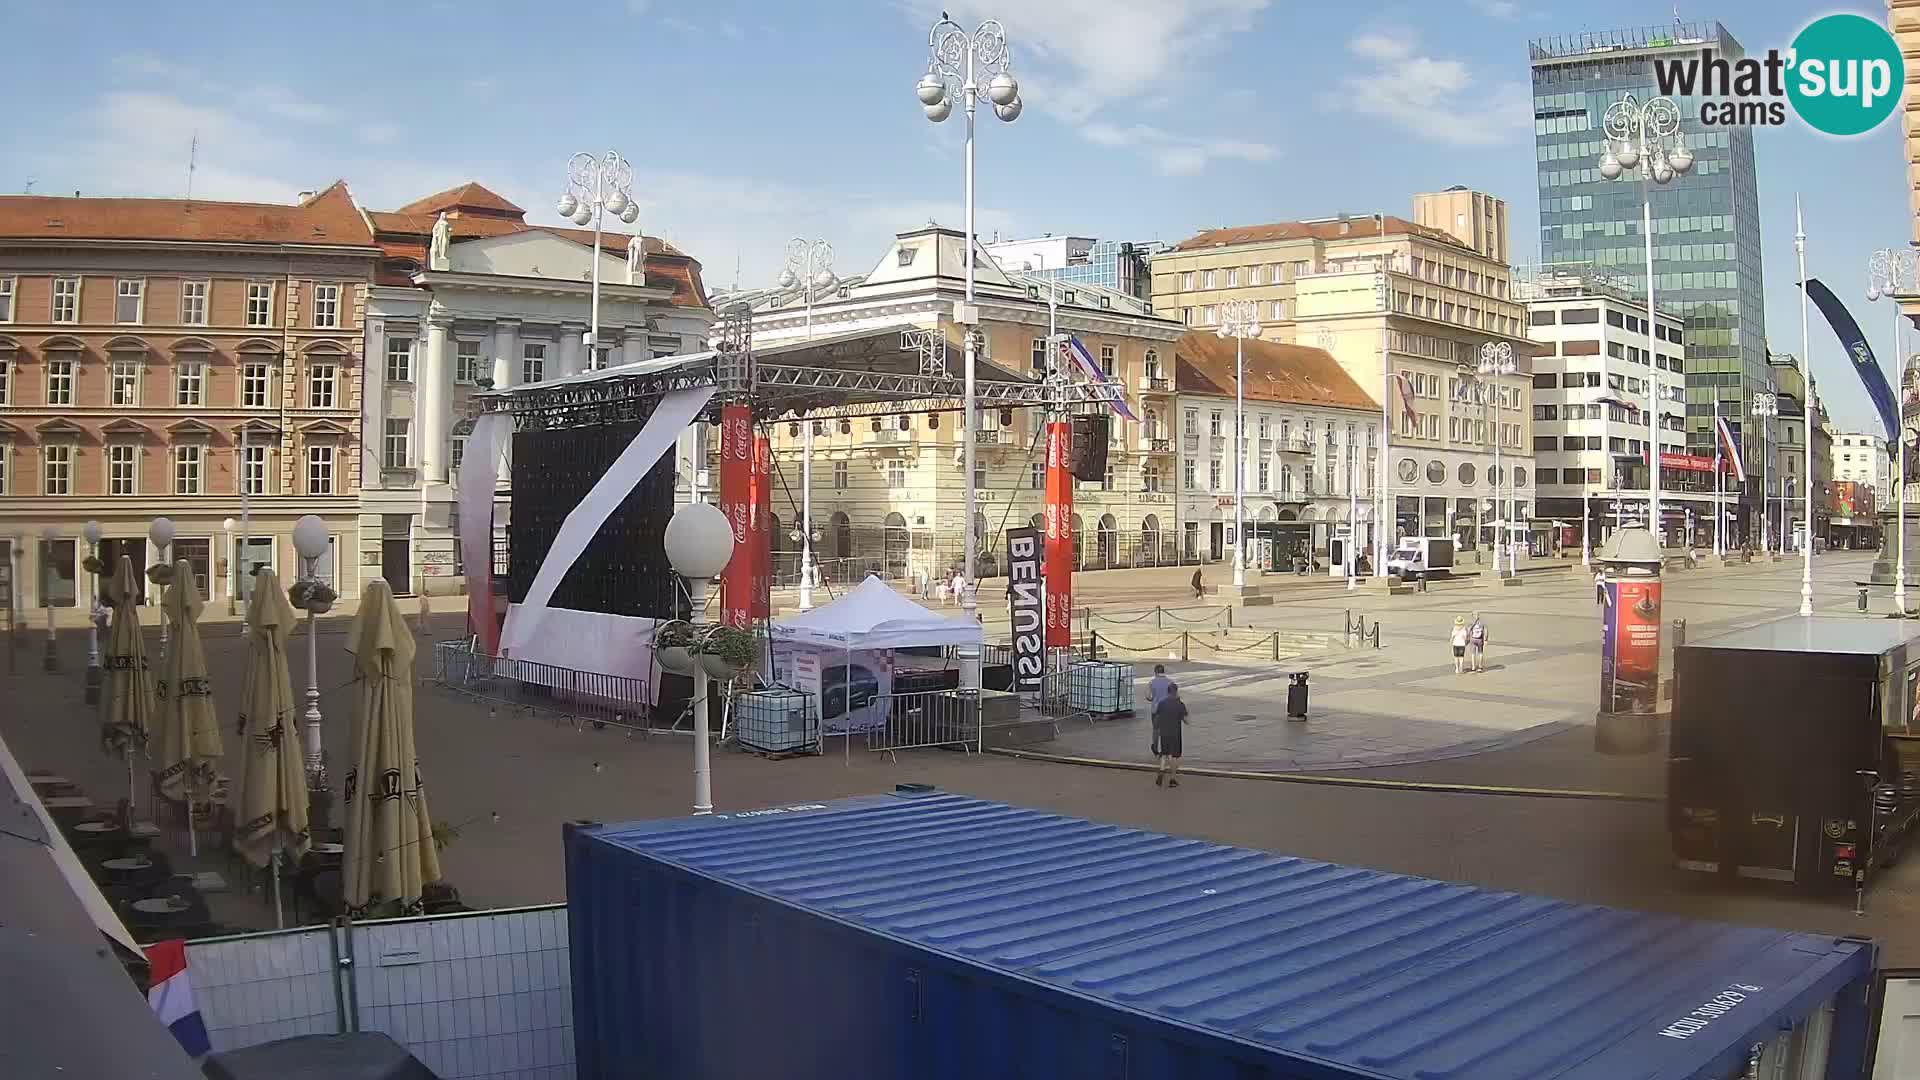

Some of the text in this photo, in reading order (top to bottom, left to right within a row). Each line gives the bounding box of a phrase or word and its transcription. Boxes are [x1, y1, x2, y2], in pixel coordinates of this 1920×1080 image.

[735, 417, 747, 460] Coca-Cola
[734, 503, 747, 544] Coca-Cola
[1691, 990, 1747, 1019] 300629
